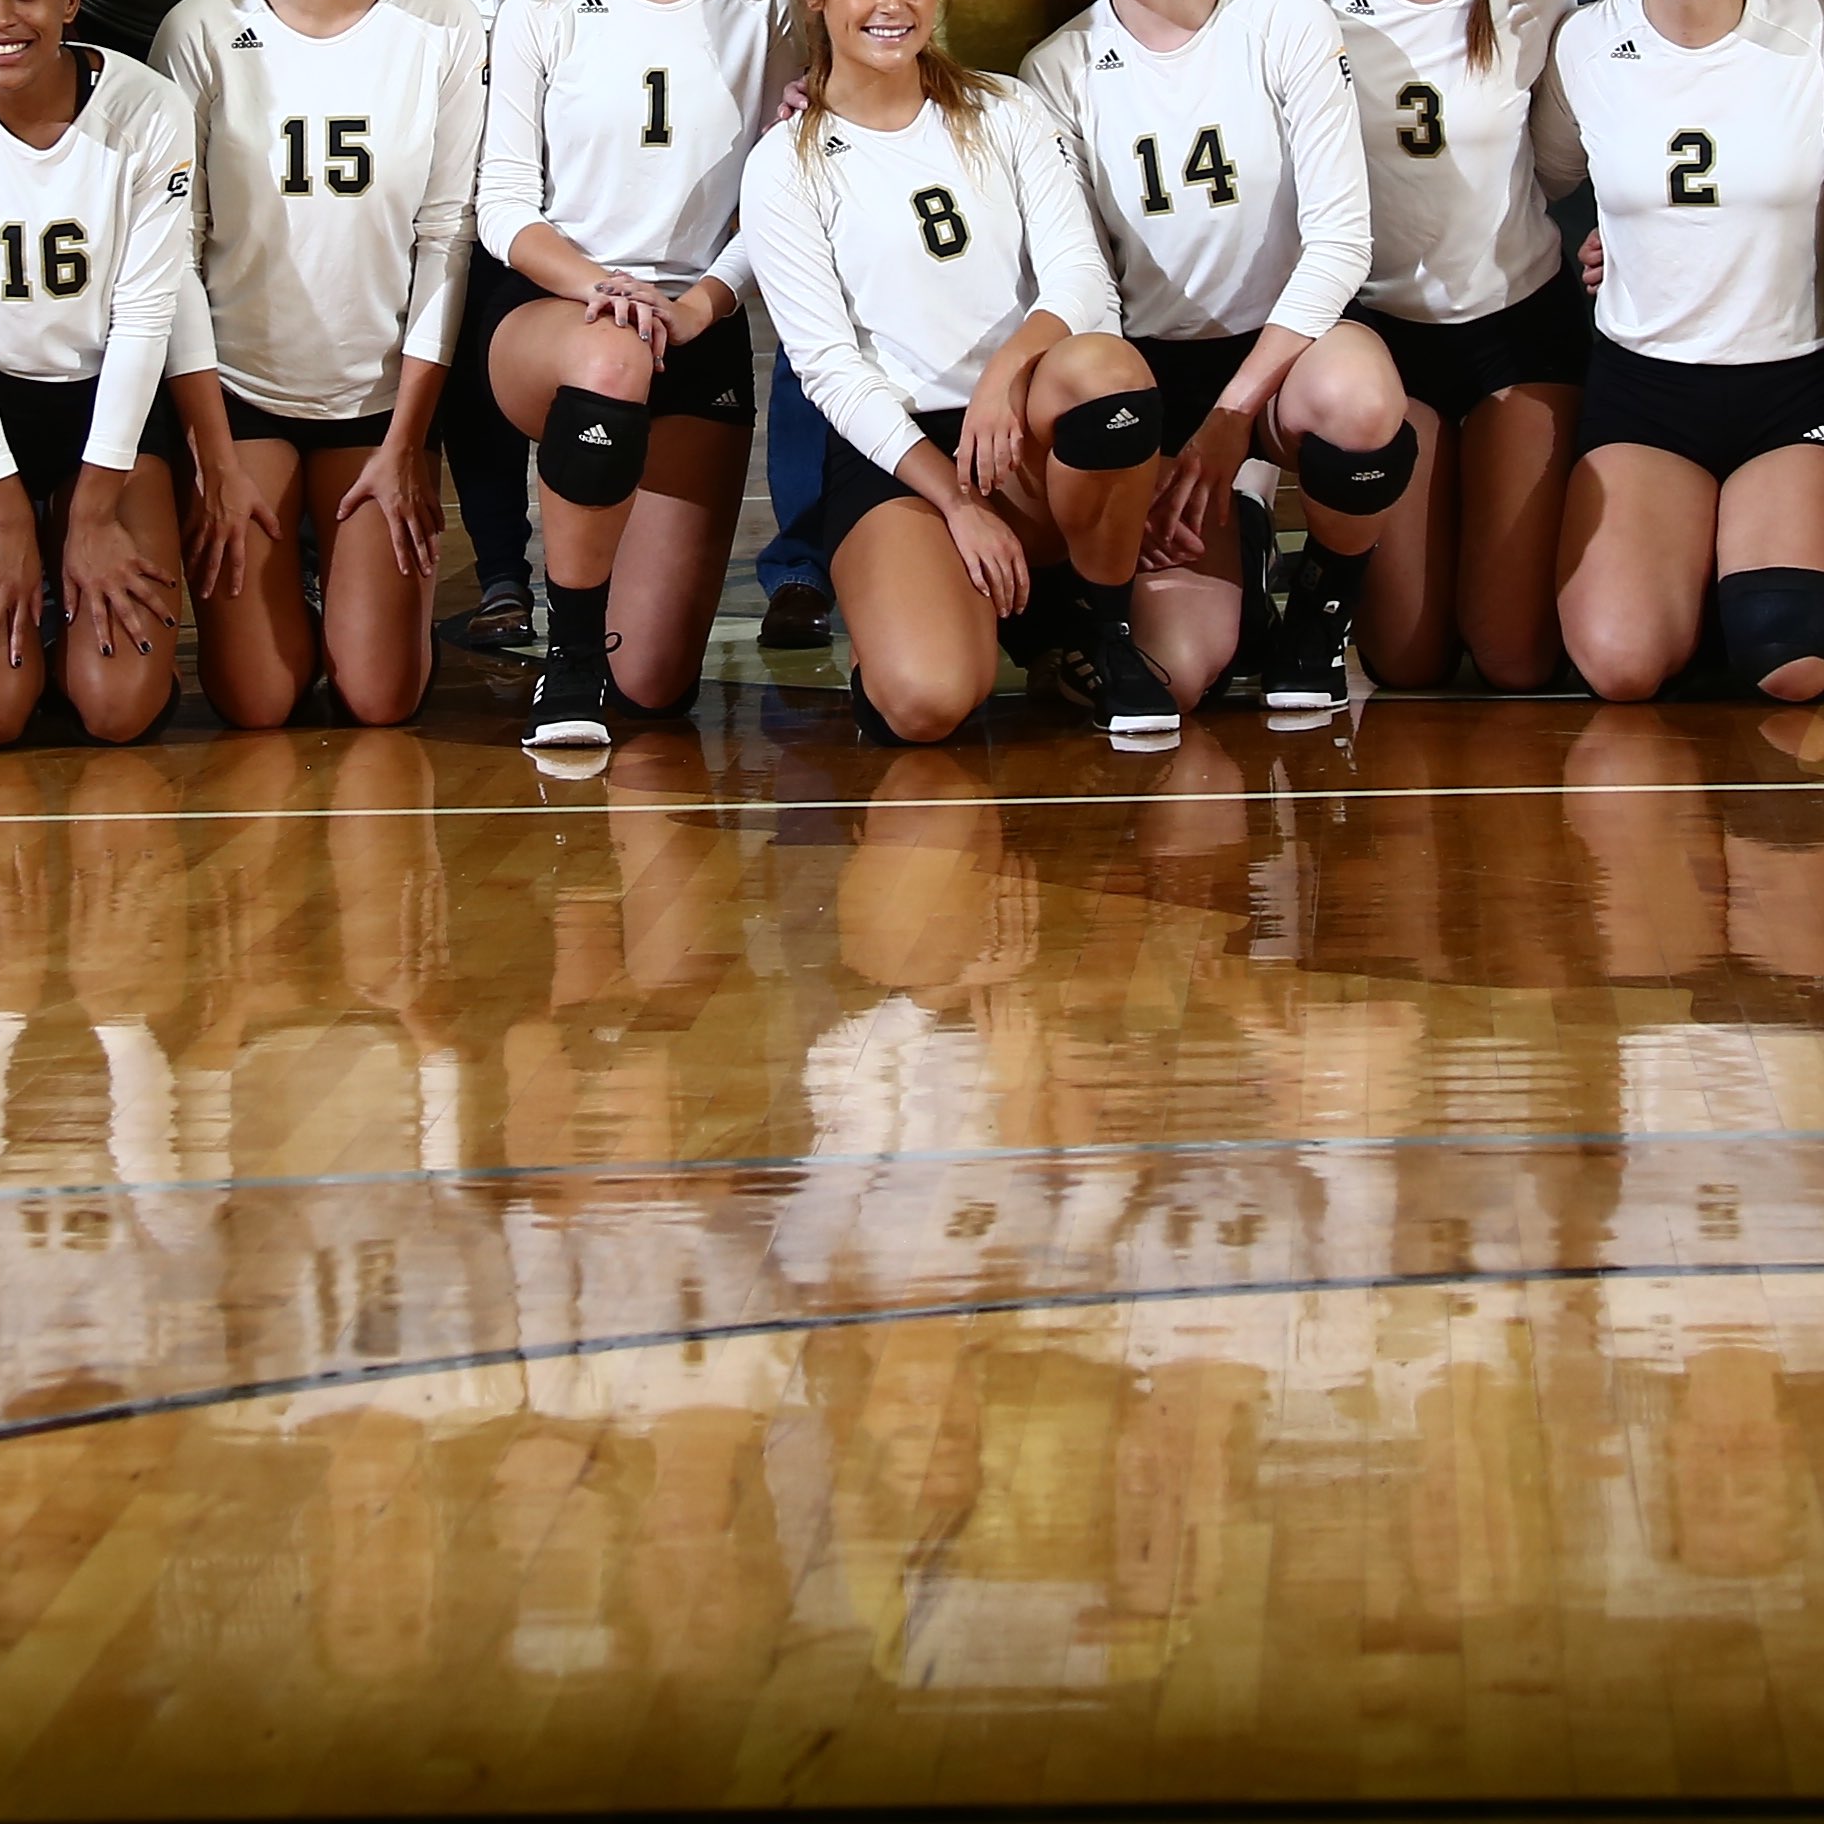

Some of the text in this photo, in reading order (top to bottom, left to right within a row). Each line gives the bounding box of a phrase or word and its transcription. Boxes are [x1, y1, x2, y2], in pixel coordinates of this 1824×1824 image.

[577, 6, 609, 14] adidas
[1094, 60, 1125, 71] adidas
[640, 67, 673, 149] 1
[1395, 81, 1447, 159] 3
[280, 115, 375, 197] 15
[1131, 124, 1239, 217] 14
[1666, 128, 1720, 208] 2
[909, 184, 972, 263] 8
